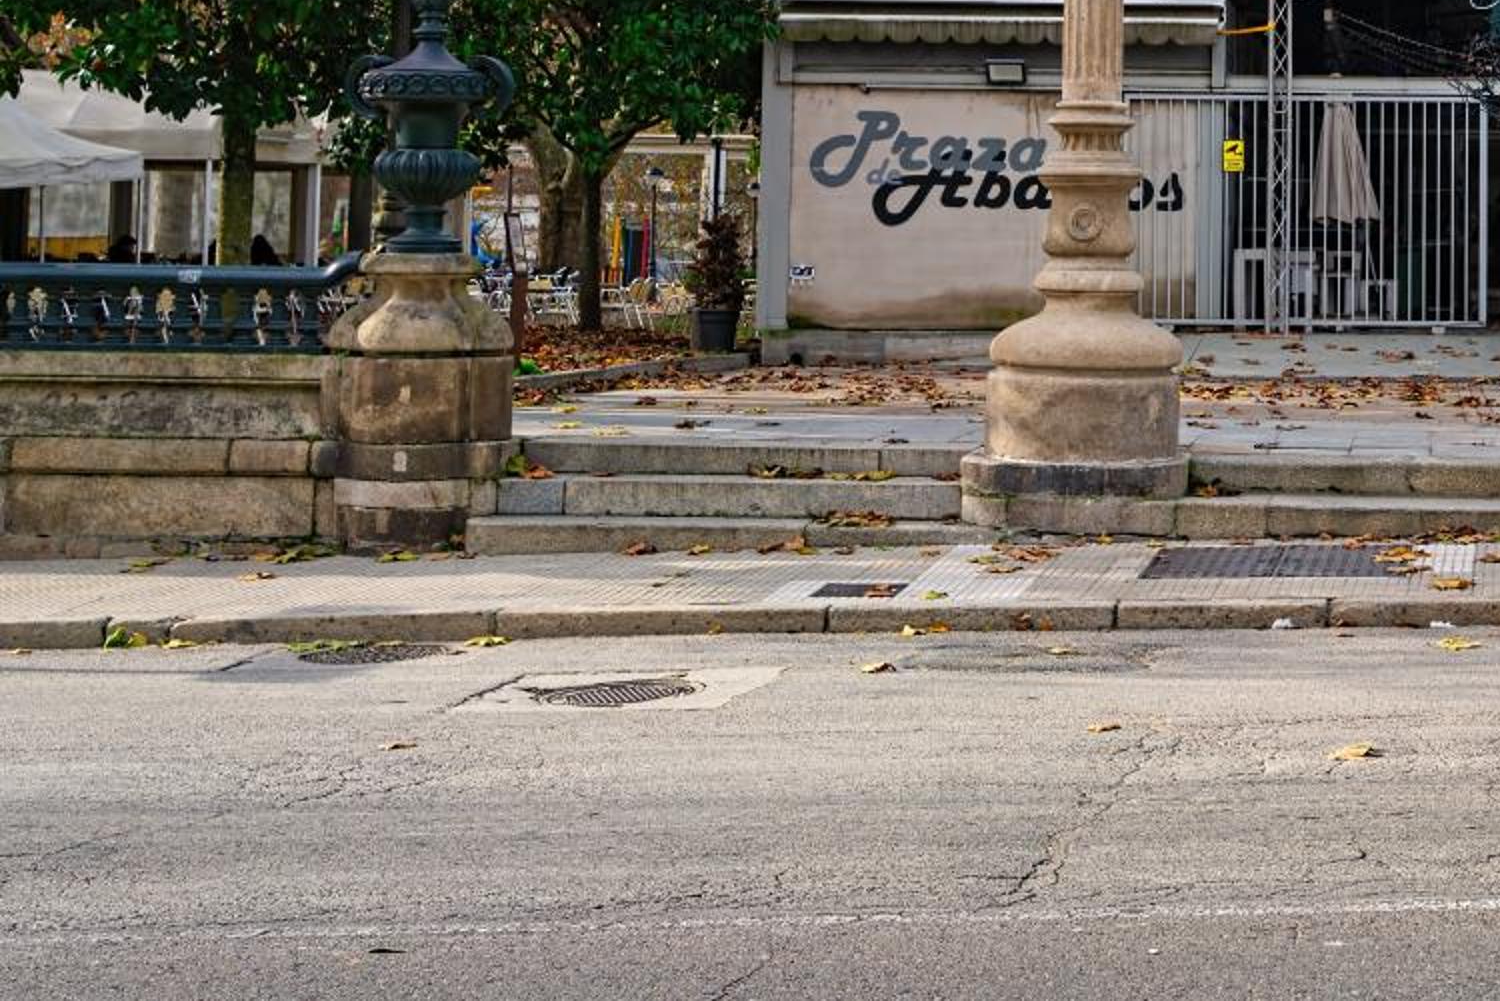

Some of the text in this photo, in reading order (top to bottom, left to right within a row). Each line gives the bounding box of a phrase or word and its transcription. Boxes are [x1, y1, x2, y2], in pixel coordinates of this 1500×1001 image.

[810, 111, 1047, 188] Praza
[867, 159, 902, 185] de
[872, 149, 1183, 227] Abaos
